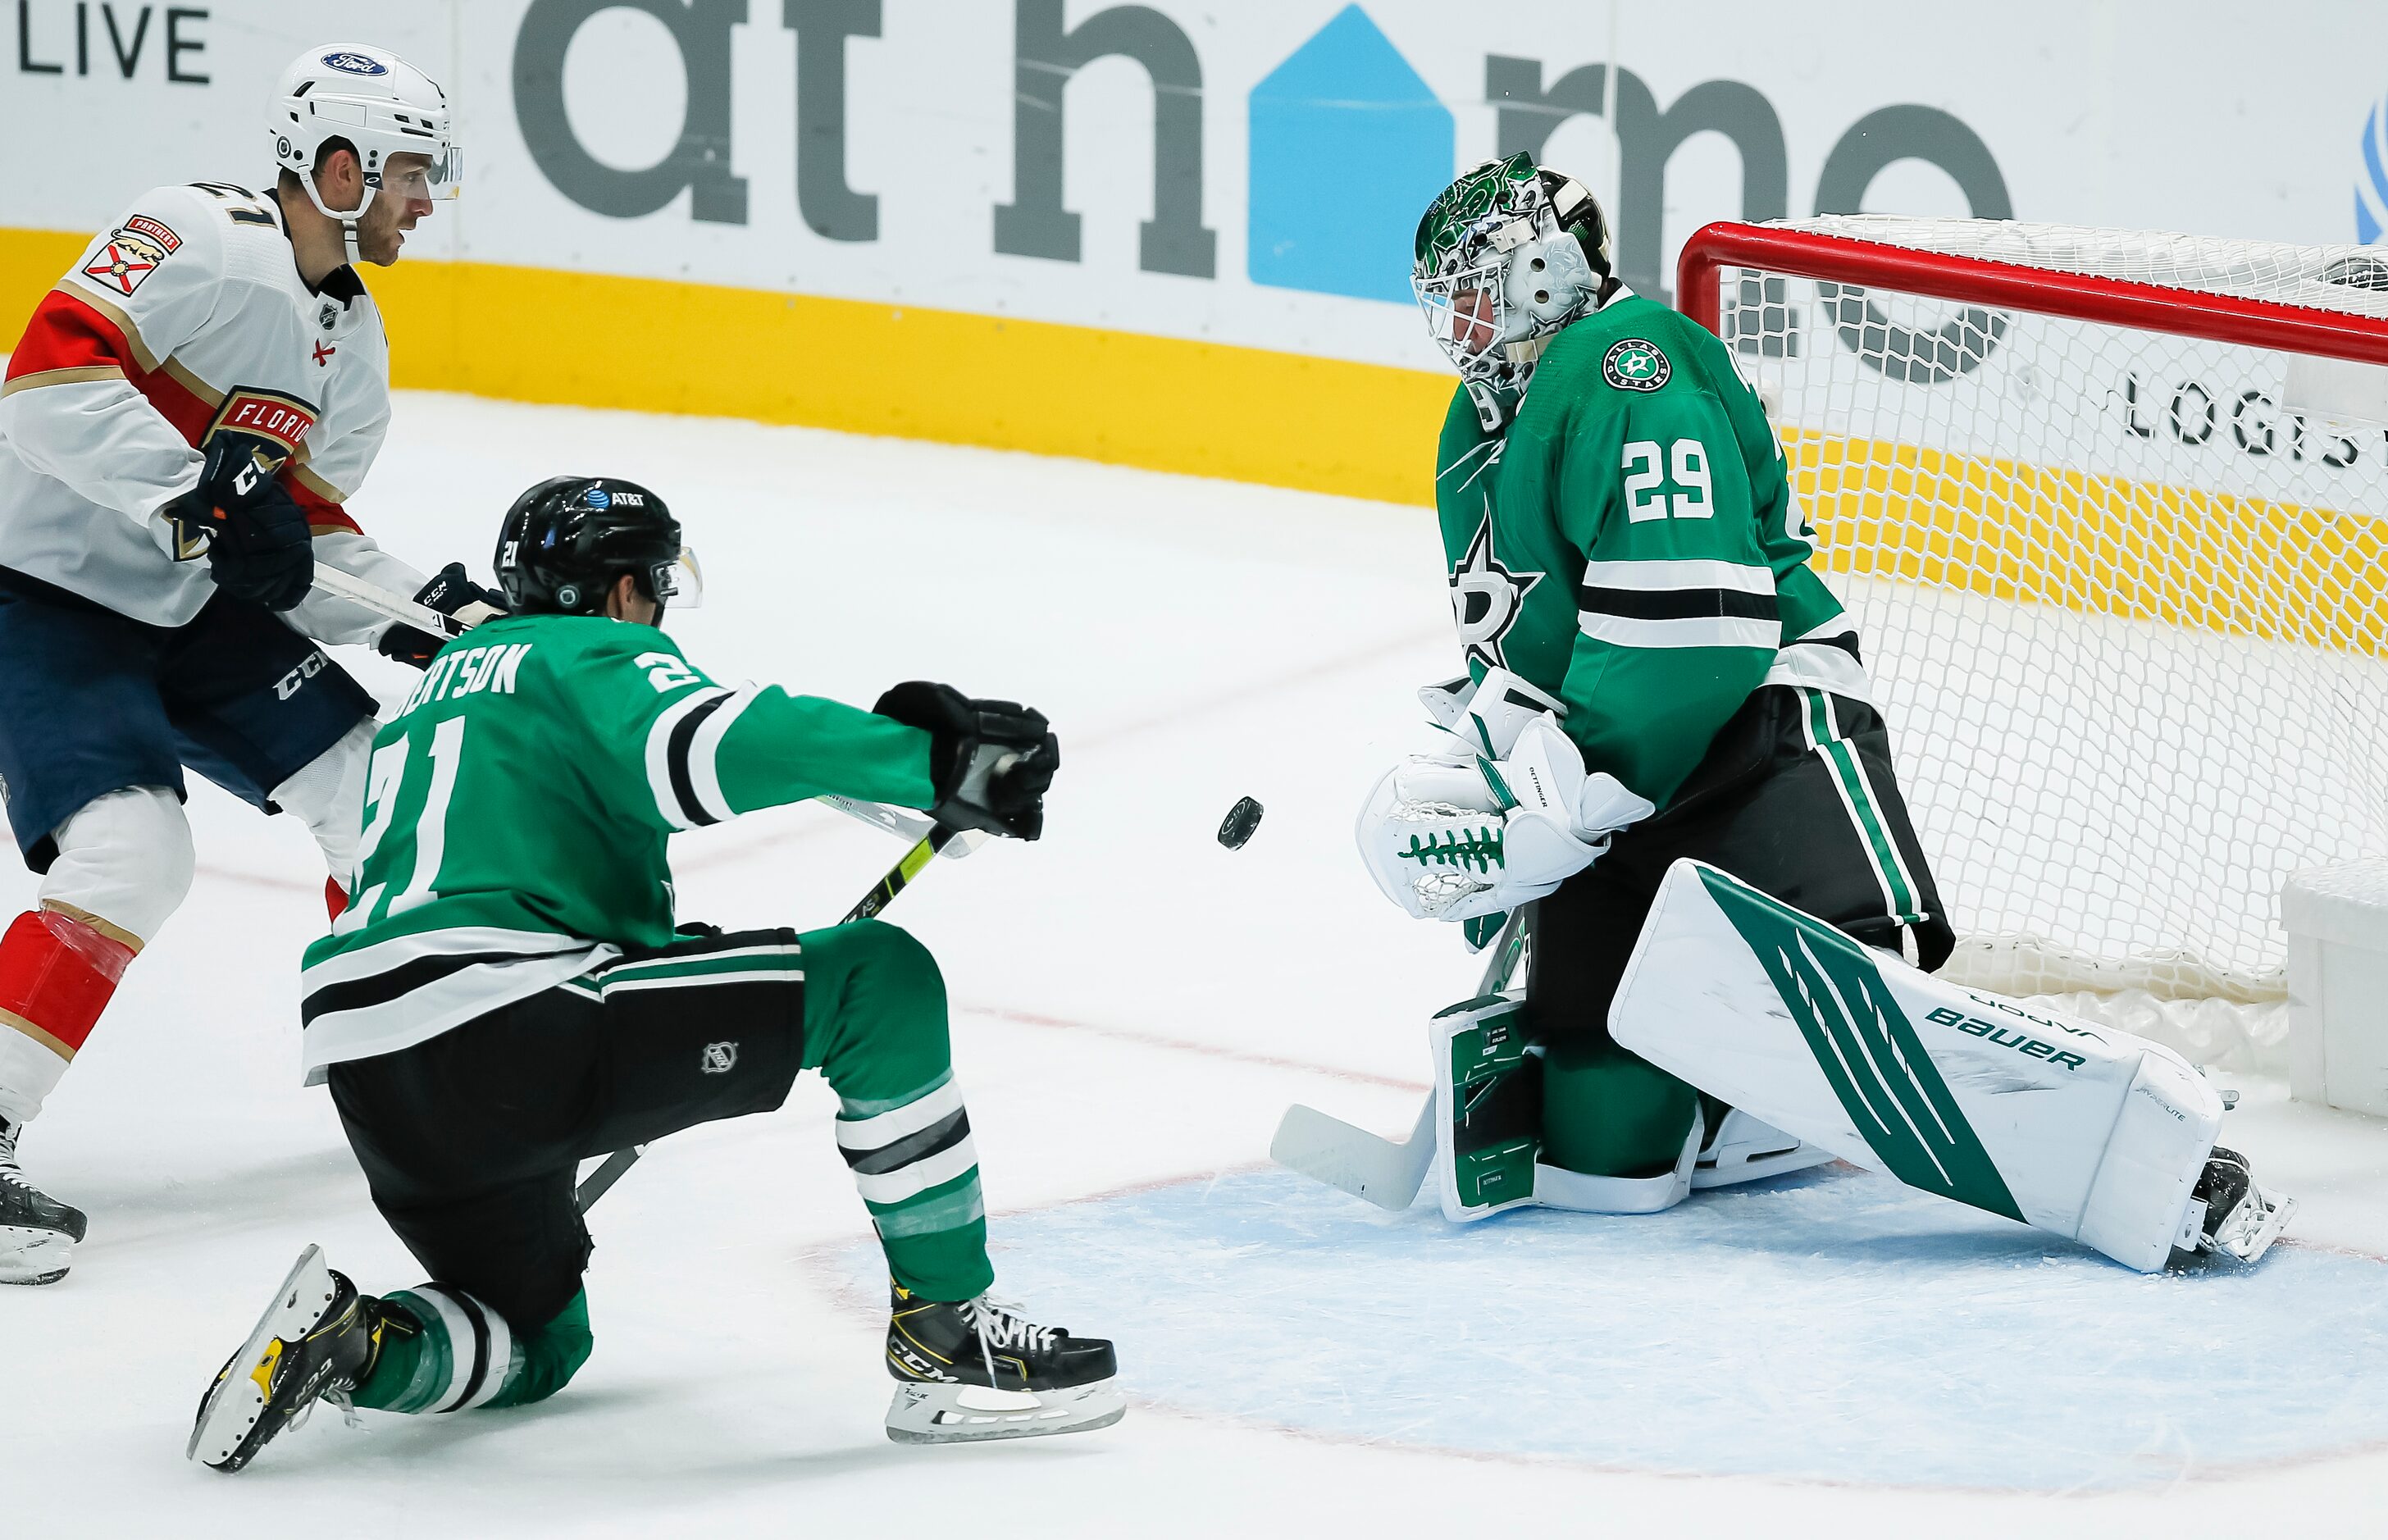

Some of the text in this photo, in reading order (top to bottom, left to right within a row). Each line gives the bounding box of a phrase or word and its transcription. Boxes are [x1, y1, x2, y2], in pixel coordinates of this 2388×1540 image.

[19, 0, 210, 83] LIVE
[331, 53, 376, 73] Ford
[135, 220, 175, 247] PANTHERS
[1607, 342, 1660, 374] DALLAS
[1620, 367, 1667, 389] STARS
[235, 403, 311, 444] FLORID
[1621, 437, 1715, 524] 29
[611, 492, 645, 507] AT&T
[501, 540, 519, 568] 21
[423, 581, 447, 606] CCM
[1529, 766, 1548, 808] OETTINGER
[331, 715, 466, 938] 21
[890, 1335, 959, 1383] CCM
